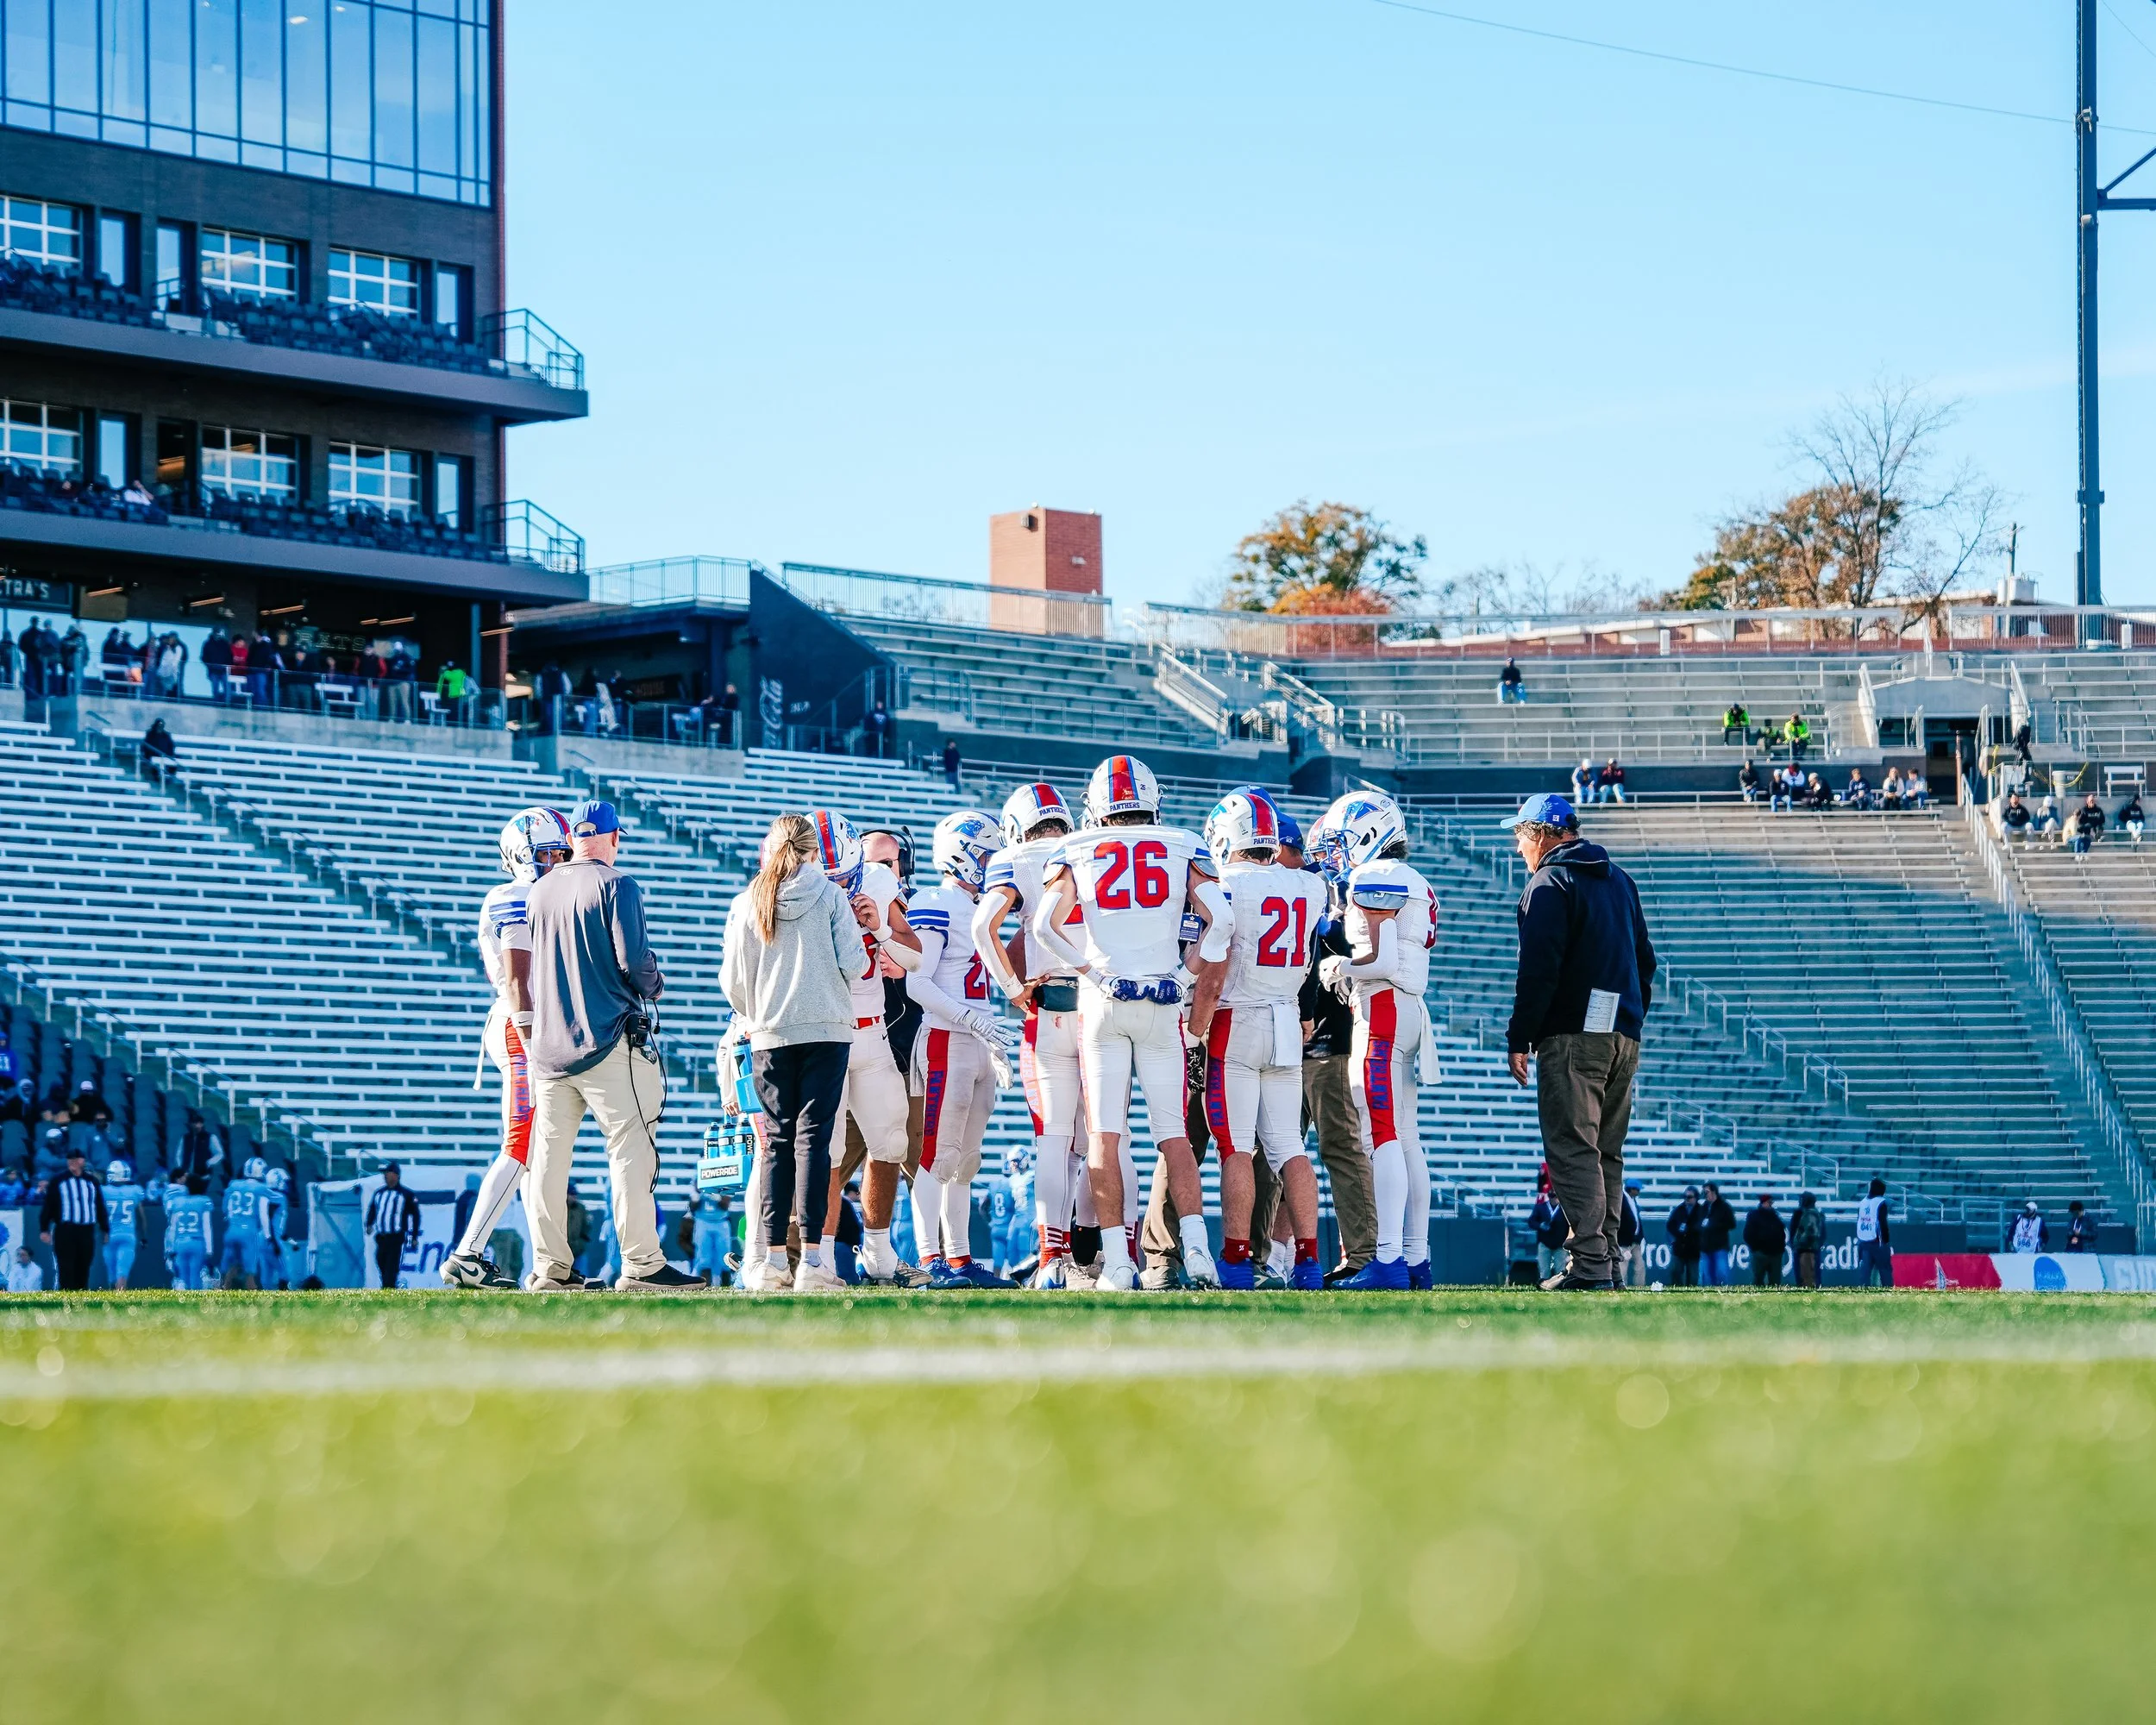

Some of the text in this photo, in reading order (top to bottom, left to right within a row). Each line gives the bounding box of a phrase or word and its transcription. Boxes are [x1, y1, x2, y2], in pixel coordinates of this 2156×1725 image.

[0, 579, 49, 599] TRA'S
[1039, 806, 1067, 817] PANTHERS
[1110, 801, 1140, 812] PANTHERS
[1094, 840, 1169, 910] 26
[1257, 896, 1307, 968] 21
[1371, 1040, 1389, 1110] PANTHERS
[701, 1166, 738, 1180] POWERADE
[106, 1200, 134, 1225] 75
